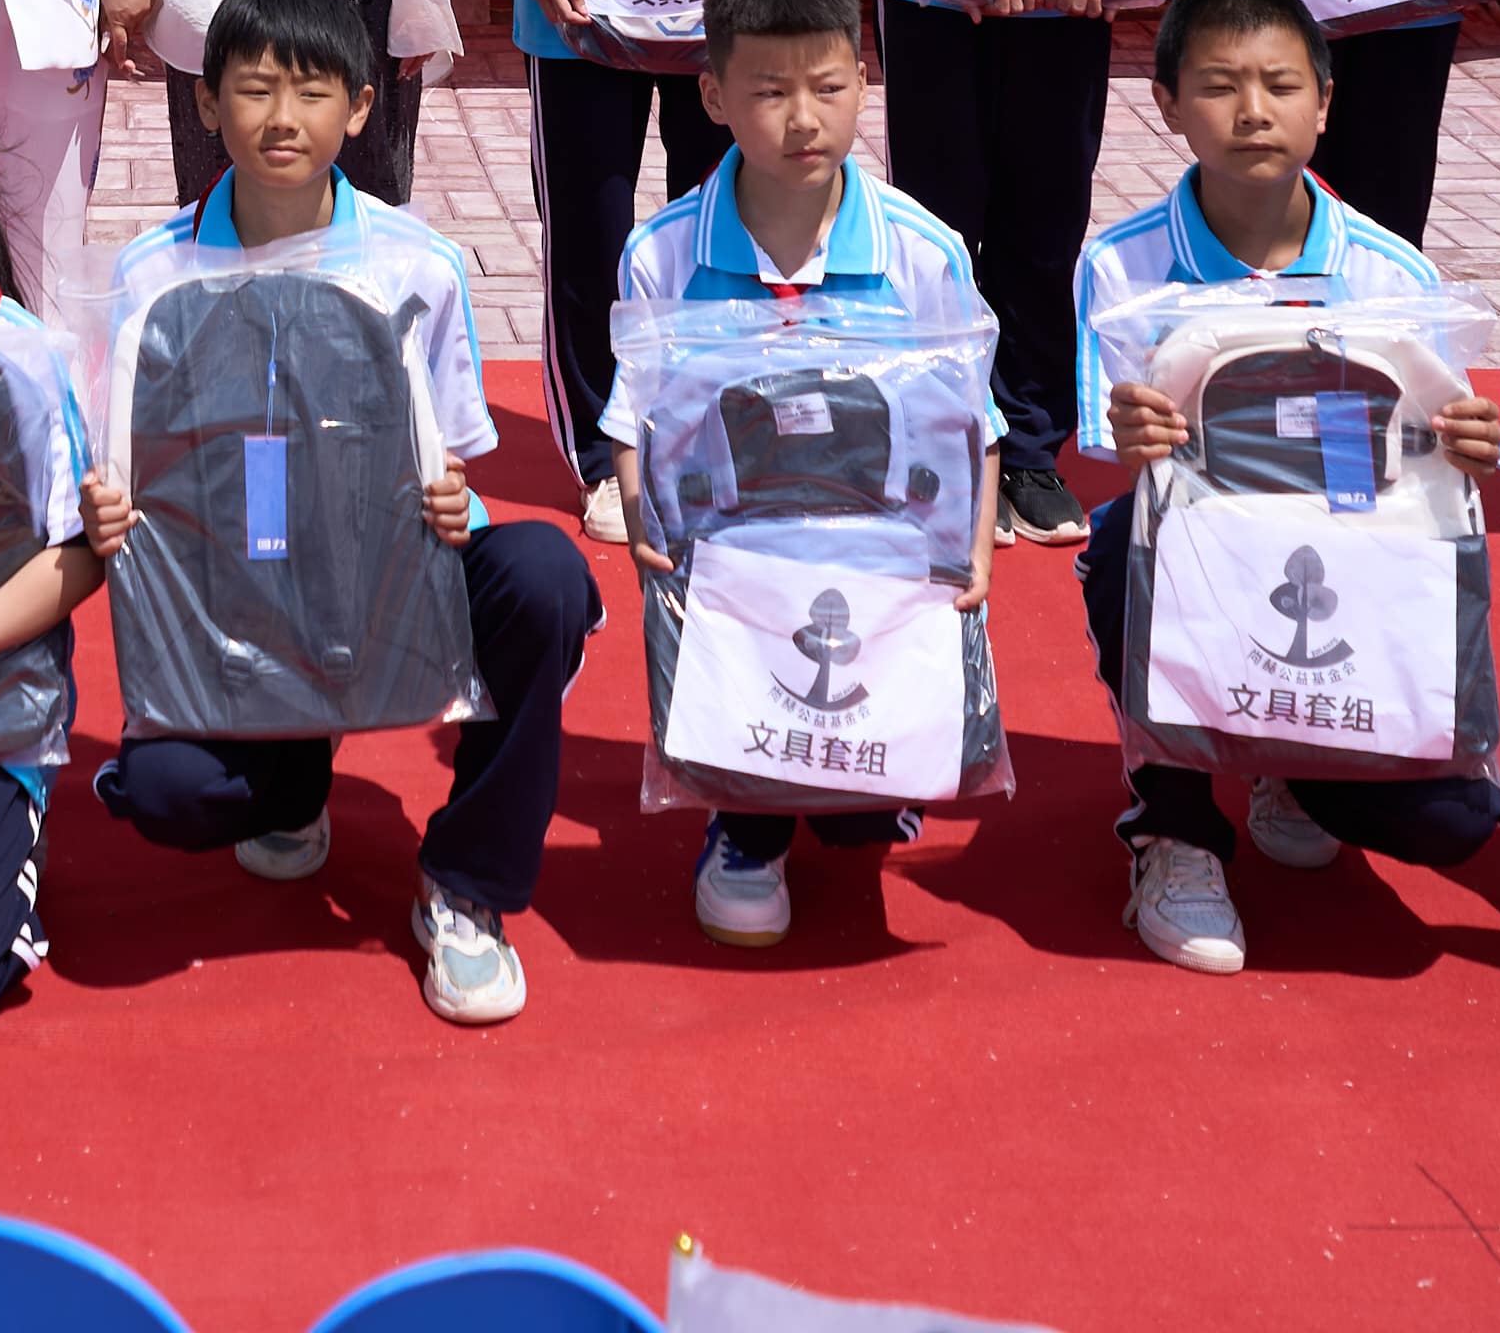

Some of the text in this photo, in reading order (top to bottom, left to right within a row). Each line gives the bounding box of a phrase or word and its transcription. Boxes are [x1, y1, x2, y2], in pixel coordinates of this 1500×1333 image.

[1246, 651, 1357, 685] 尚赫公益基金会
[766, 687, 870, 729] 尚赫公益基金会
[1226, 683, 1375, 734] 文具套组
[743, 720, 887, 777] 文具套组
